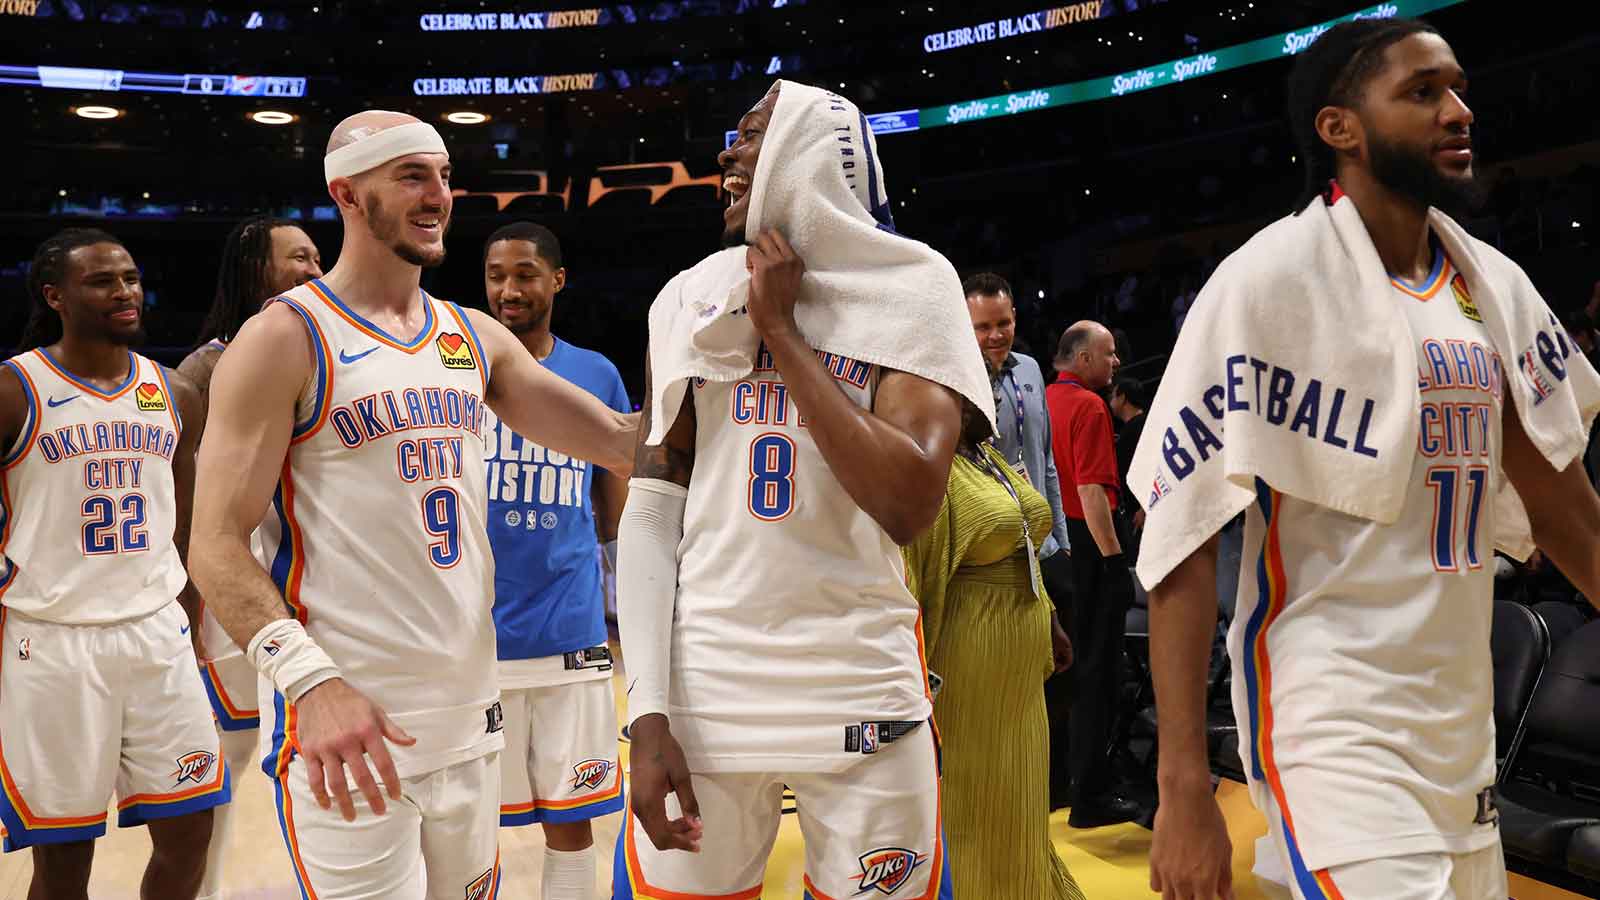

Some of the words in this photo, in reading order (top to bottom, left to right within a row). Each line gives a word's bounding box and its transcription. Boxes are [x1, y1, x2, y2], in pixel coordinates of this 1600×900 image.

[420, 13, 498, 31] CELEBRATE
[500, 13, 544, 29] BLACK
[546, 9, 601, 28] HISTORY
[923, 22, 995, 52] CELEBRATE
[998, 12, 1042, 38] BLACK
[1045, 0, 1104, 28] HISTORY
[413, 78, 492, 95] CELEBRATE
[494, 77, 539, 94] BLACK
[541, 73, 597, 93] HISTORY
[1112, 69, 1155, 96] Sprite
[1172, 54, 1217, 82] Sprite
[946, 100, 989, 124] Sprite
[1005, 89, 1049, 114] Sprite
[38, 421, 175, 464] OKLAHOMA
[1418, 402, 1491, 458] CITY
[85, 458, 144, 490] CITY
[397, 437, 463, 482] CITY
[747, 431, 797, 522] 8
[486, 462, 585, 508] ISTORY
[81, 492, 149, 556] 22
[421, 486, 462, 569] 9
[1426, 465, 1488, 572] 11
[861, 856, 905, 888] OKC
